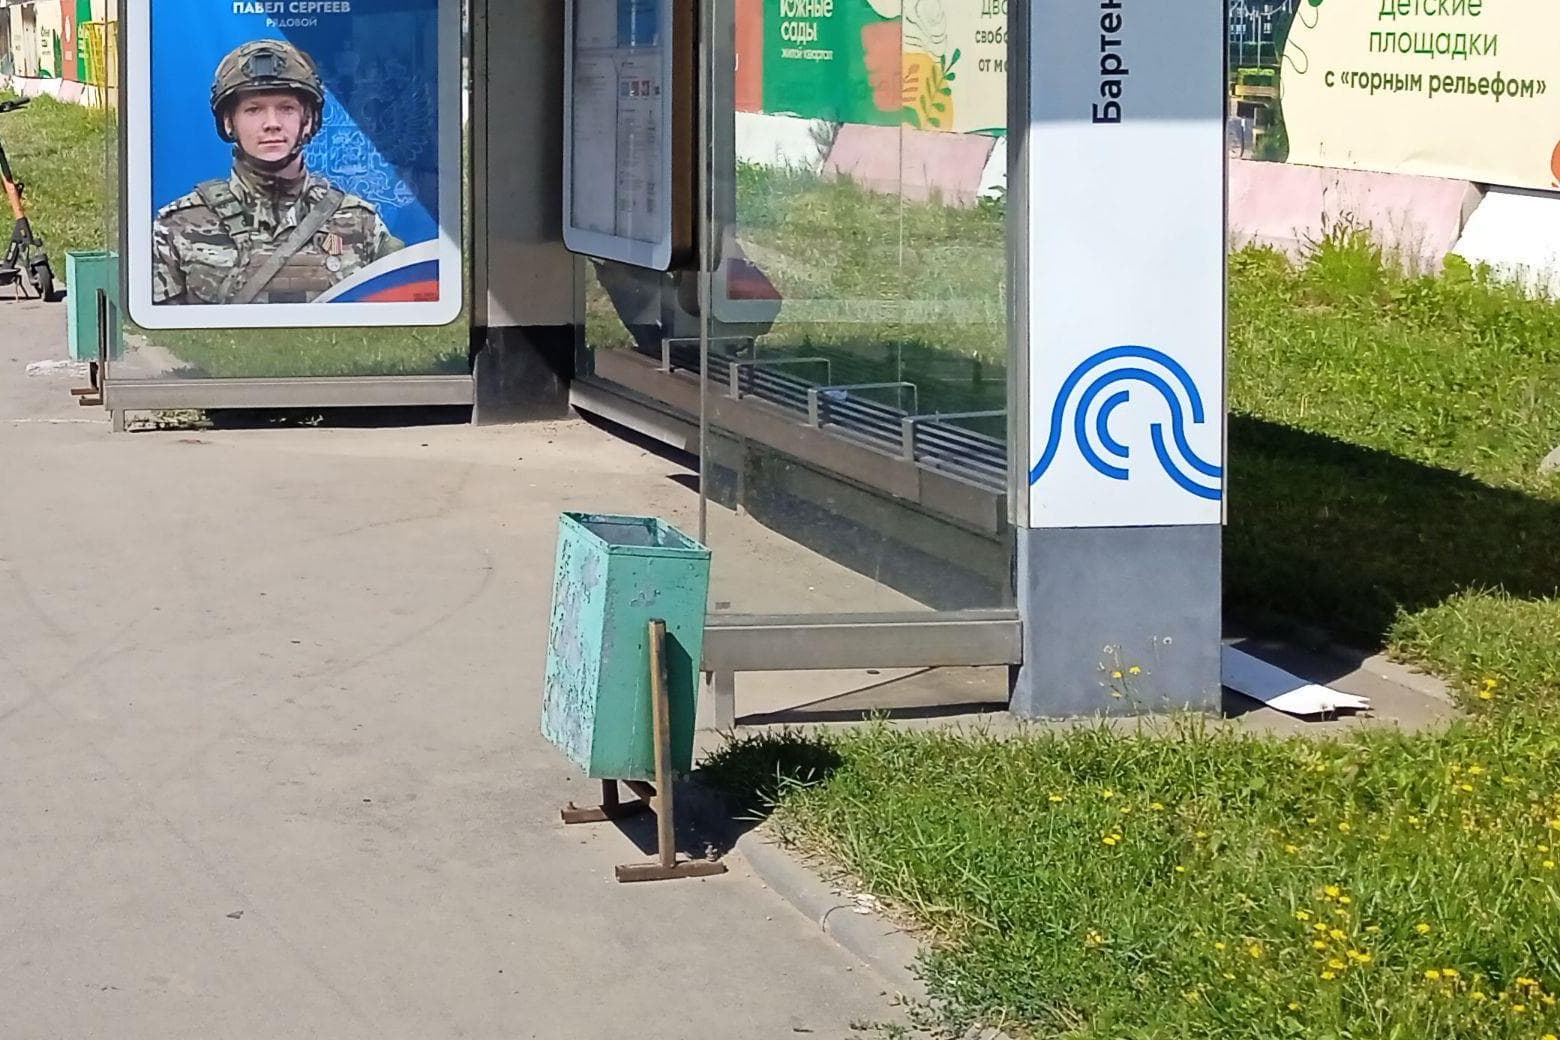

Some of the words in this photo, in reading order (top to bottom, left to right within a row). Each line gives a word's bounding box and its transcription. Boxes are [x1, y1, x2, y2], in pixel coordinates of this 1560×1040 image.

[233, 1, 284, 14] ПАВЕЛ
[289, 1, 351, 13] СЕРГЕЕВ
[780, 21, 818, 45] сады
[1369, 31, 1498, 60] площадки
[978, 59, 991, 73] от
[1324, 70, 1335, 88] с
[1340, 70, 1423, 96] «горным
[1428, 71, 1547, 103] рельефом»
